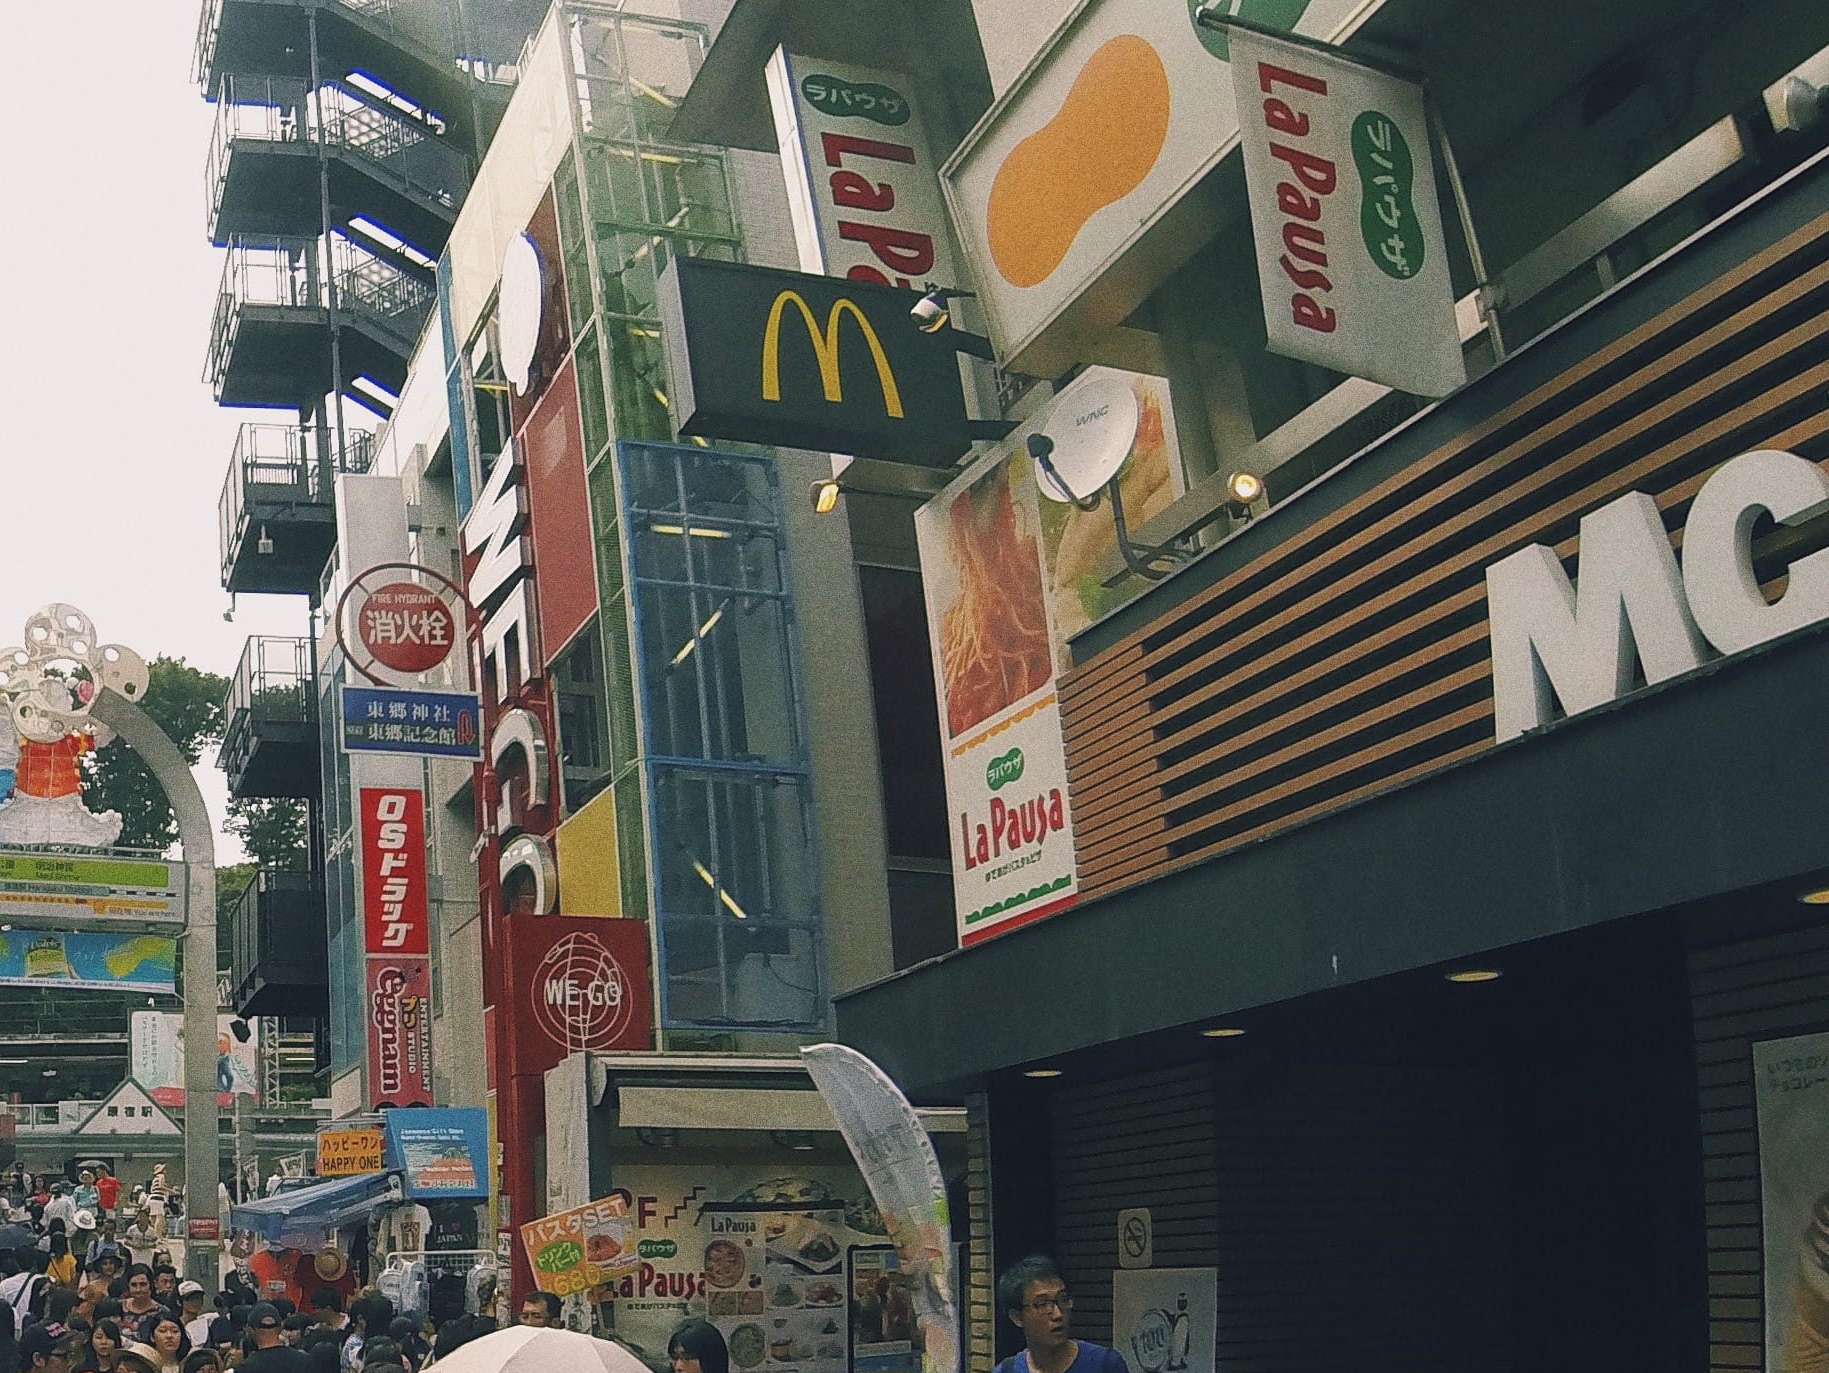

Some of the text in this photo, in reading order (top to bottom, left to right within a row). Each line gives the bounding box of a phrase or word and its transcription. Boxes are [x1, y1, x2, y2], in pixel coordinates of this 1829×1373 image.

[821, 131, 916, 213] La
[1258, 62, 1337, 333] La Pausa
[1367, 120, 1411, 277] ラパウザ
[372, 593, 437, 604] FIRE HYDRANT
[366, 609, 450, 646] 消火栓
[367, 700, 451, 723] 東郷神社
[367, 722, 456, 746] 東郷記念館
[961, 787, 1065, 871] La Pausa
[376, 794, 414, 949] OSドラッグ
[407, 1031, 418, 1074] STUDIO
[420, 997, 431, 1093] ENTERTAINMENT
[322, 1136, 379, 1153] ハッピーワン
[323, 1155, 381, 1172] HAPPY ONE
[711, 1217, 757, 1234] La Pausa
